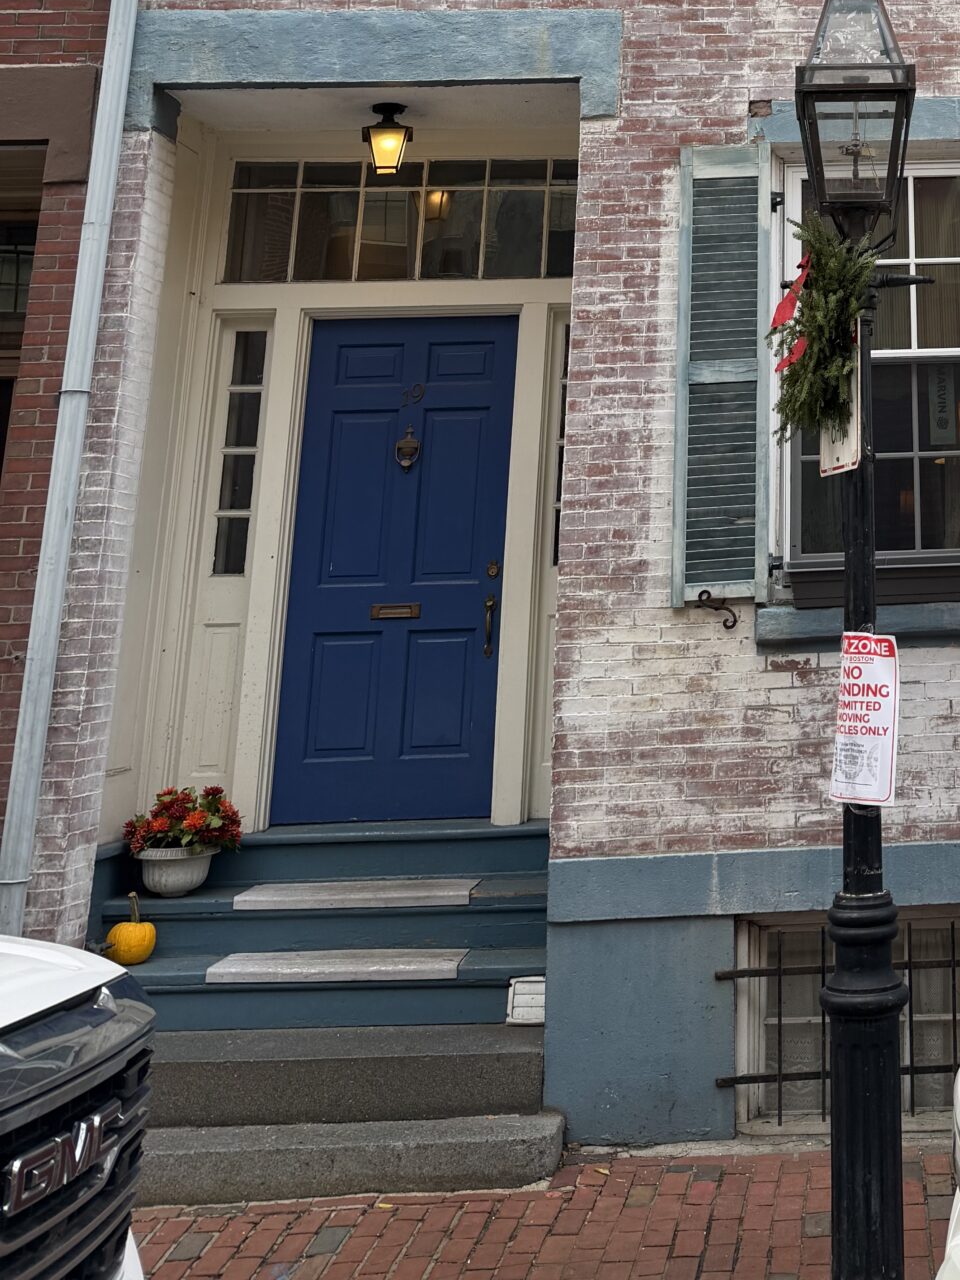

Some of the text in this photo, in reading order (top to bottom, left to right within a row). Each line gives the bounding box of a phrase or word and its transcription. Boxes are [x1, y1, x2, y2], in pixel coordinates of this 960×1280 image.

[400, 383, 425, 408] 19
[936, 365, 947, 414] MARVIN
[849, 639, 889, 656] ZONE
[843, 665, 862, 680] NO
[860, 725, 889, 736] ONLY
[3, 1097, 123, 1217] GMC
